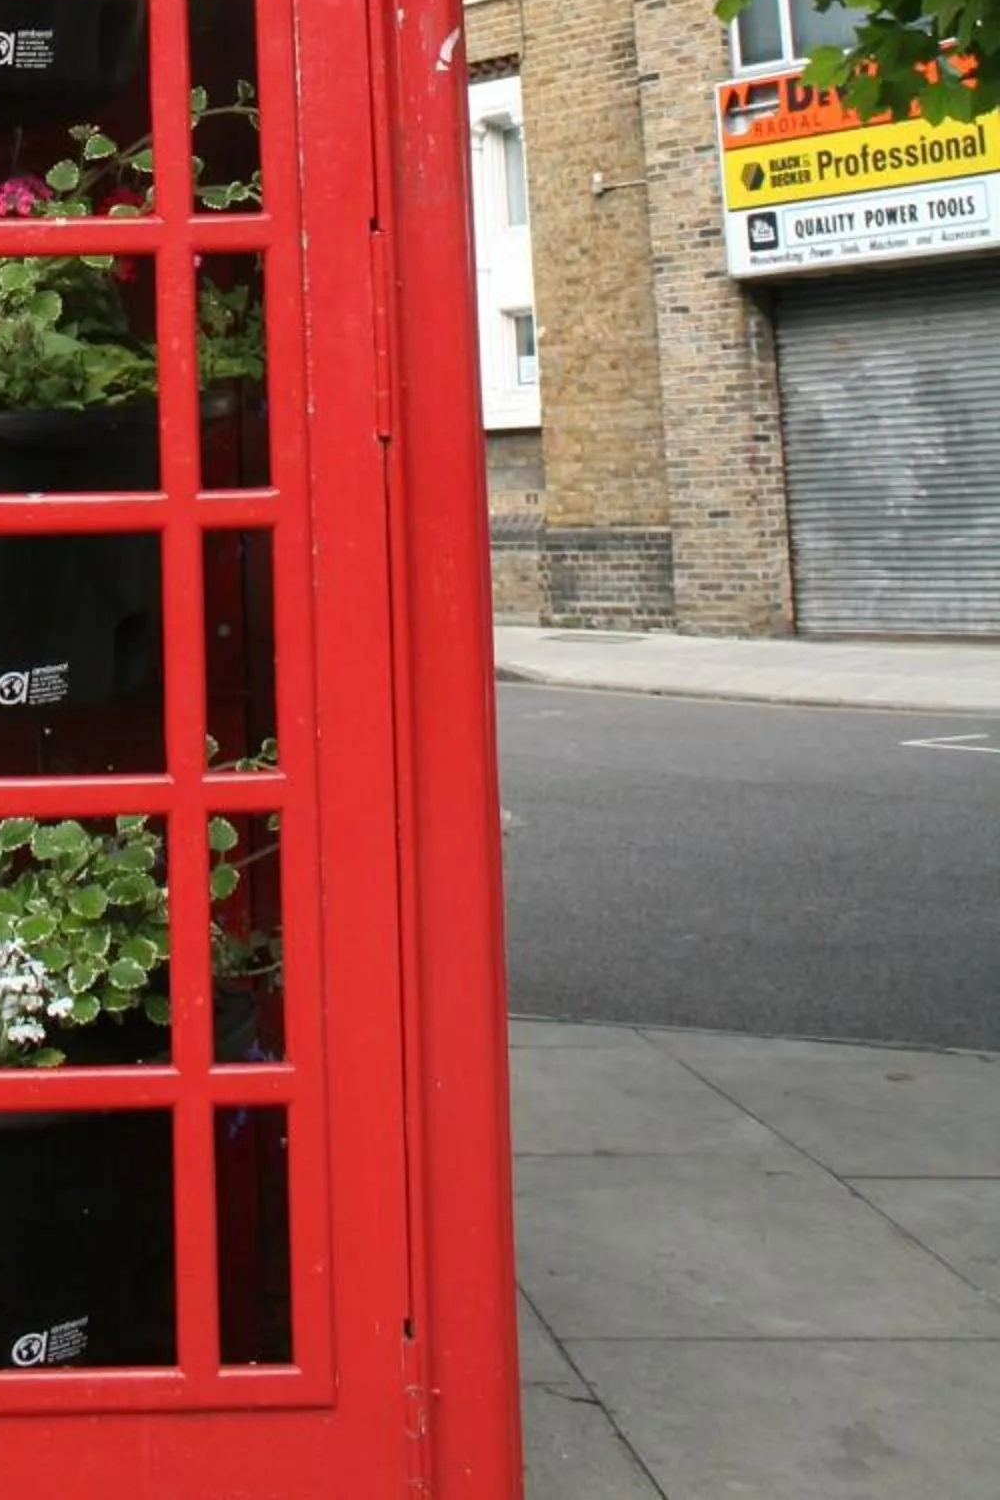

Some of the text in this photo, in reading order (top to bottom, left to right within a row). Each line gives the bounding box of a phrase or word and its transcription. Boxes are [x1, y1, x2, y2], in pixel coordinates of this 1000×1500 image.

[753, 113, 823, 136] RADIAL
[769, 155, 801, 172] BLACK
[816, 124, 987, 181] Professional
[794, 195, 976, 239] QUALITY POWER TOOLS
